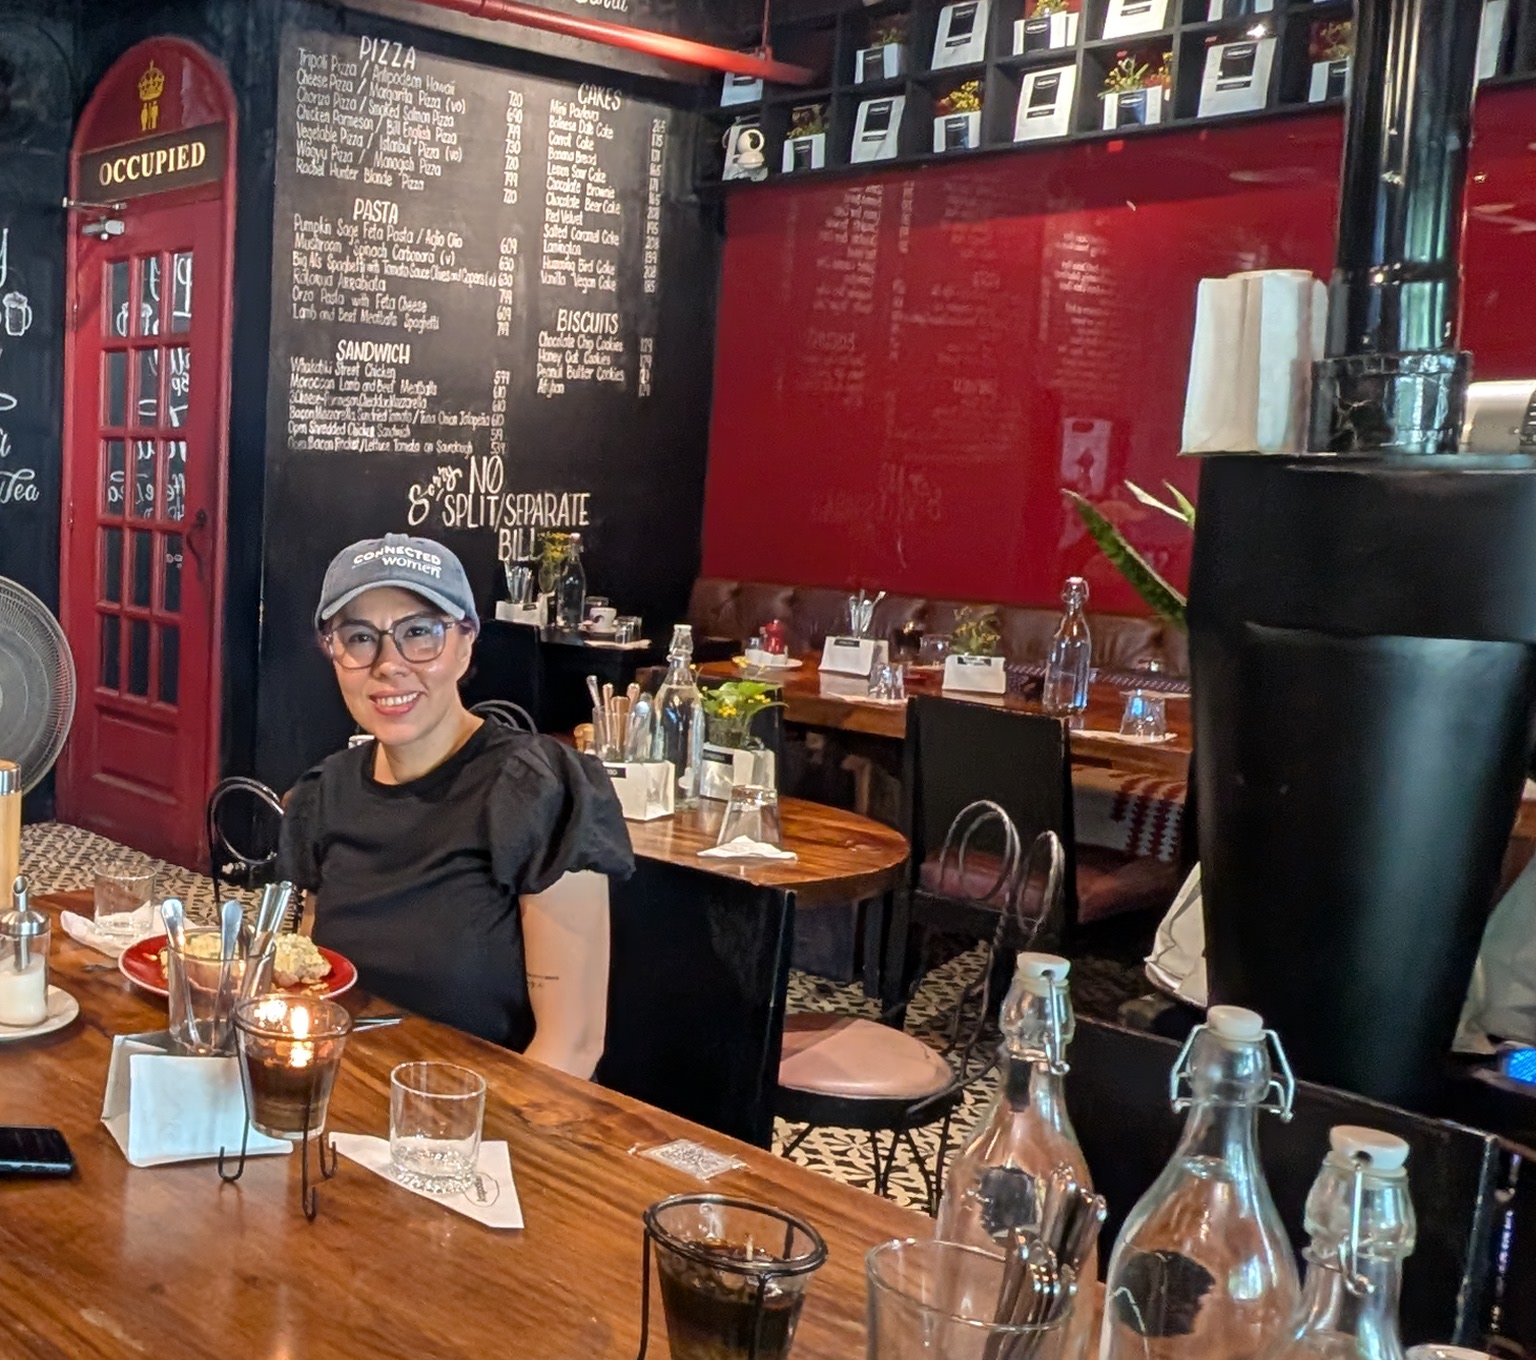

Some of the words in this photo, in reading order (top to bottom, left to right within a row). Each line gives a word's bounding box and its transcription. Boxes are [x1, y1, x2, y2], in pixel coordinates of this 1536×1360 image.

[359, 35, 416, 71] PIZZA
[578, 82, 622, 111] CAKES
[99, 140, 206, 186] OCCUPIED
[353, 198, 398, 224] PASTA
[557, 309, 618, 334] BISCUITS
[336, 339, 410, 364] SANDWICH
[469, 455, 504, 494] NO
[442, 493, 591, 532] SPLIT/SEPARATE
[353, 545, 441, 565] CONNECTED
[498, 528, 541, 561] BILL
[382, 556, 442, 578] women
